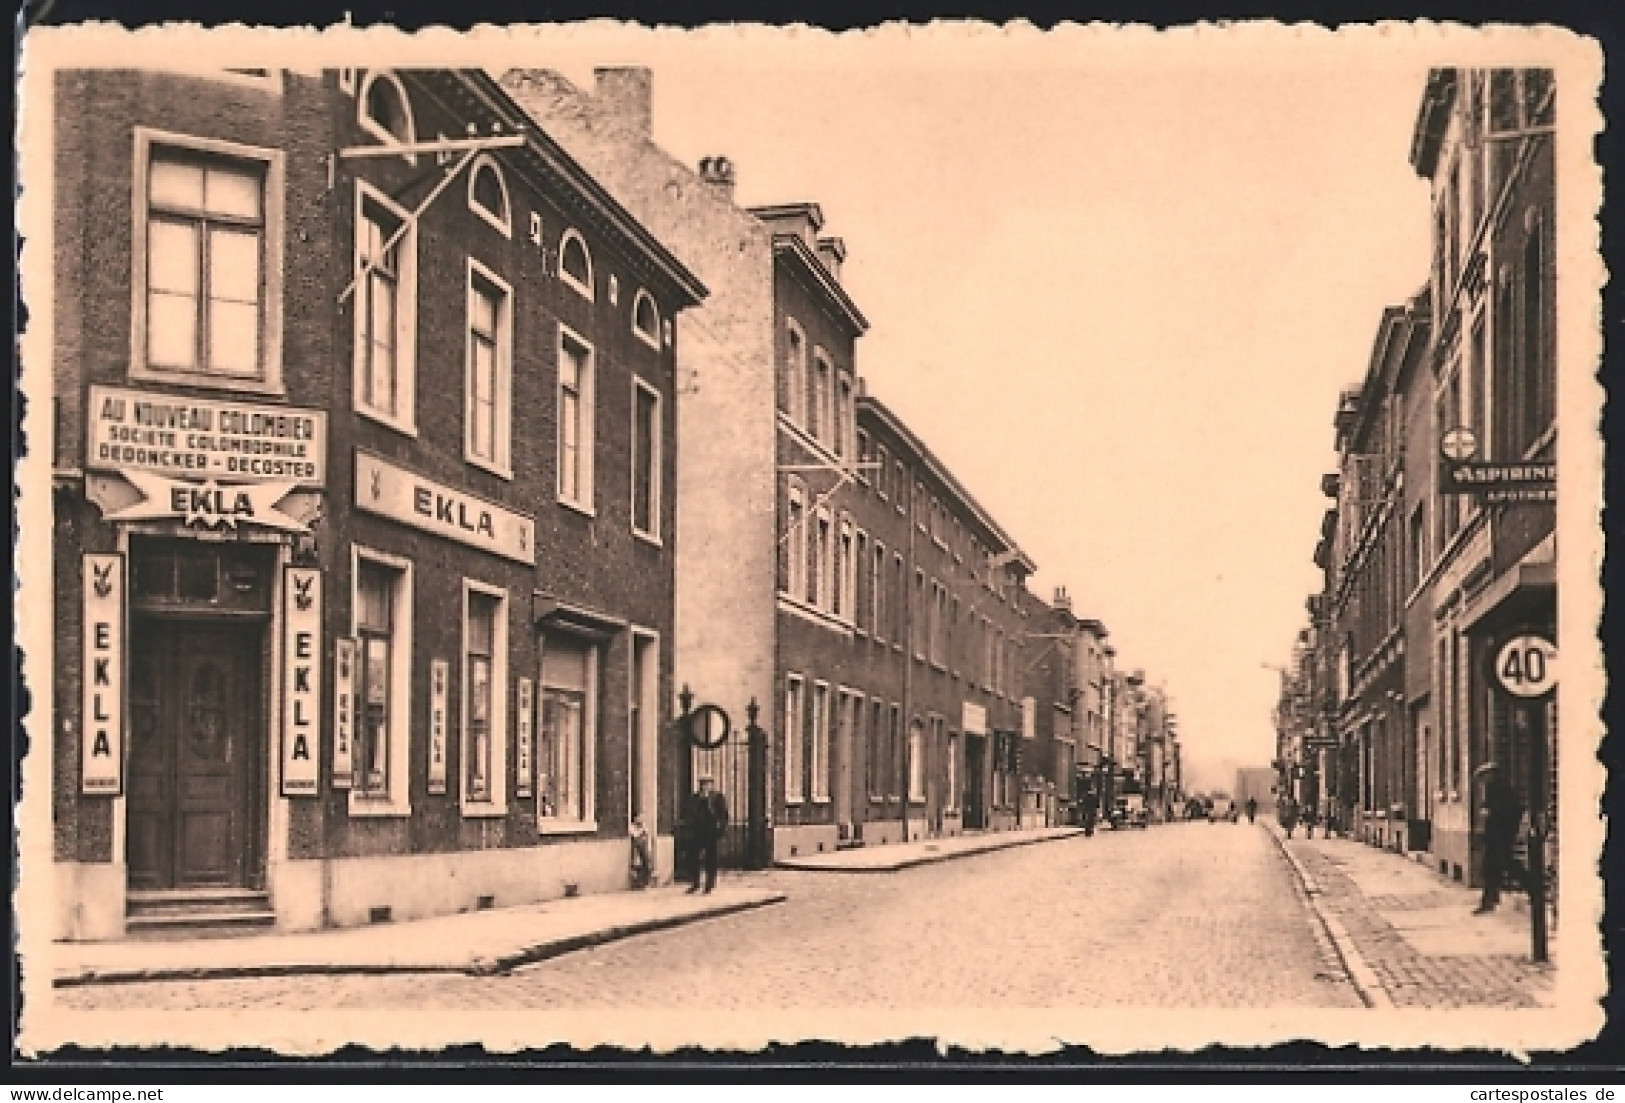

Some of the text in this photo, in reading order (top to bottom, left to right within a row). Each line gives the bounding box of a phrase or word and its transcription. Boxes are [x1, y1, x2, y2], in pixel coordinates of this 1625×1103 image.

[100, 397, 313, 441] AU NOUVEAU COLOMBIER
[100, 442, 207, 469] DEDONCKER
[227, 456, 314, 478] DECOSTER
[187, 433, 306, 458] COLOMBOPHILE
[171, 487, 254, 517] EKLA
[413, 485, 495, 540] EKLA
[1502, 647, 1545, 686] 40
[92, 624, 109, 756] EKLA
[293, 633, 310, 760] EKLA
